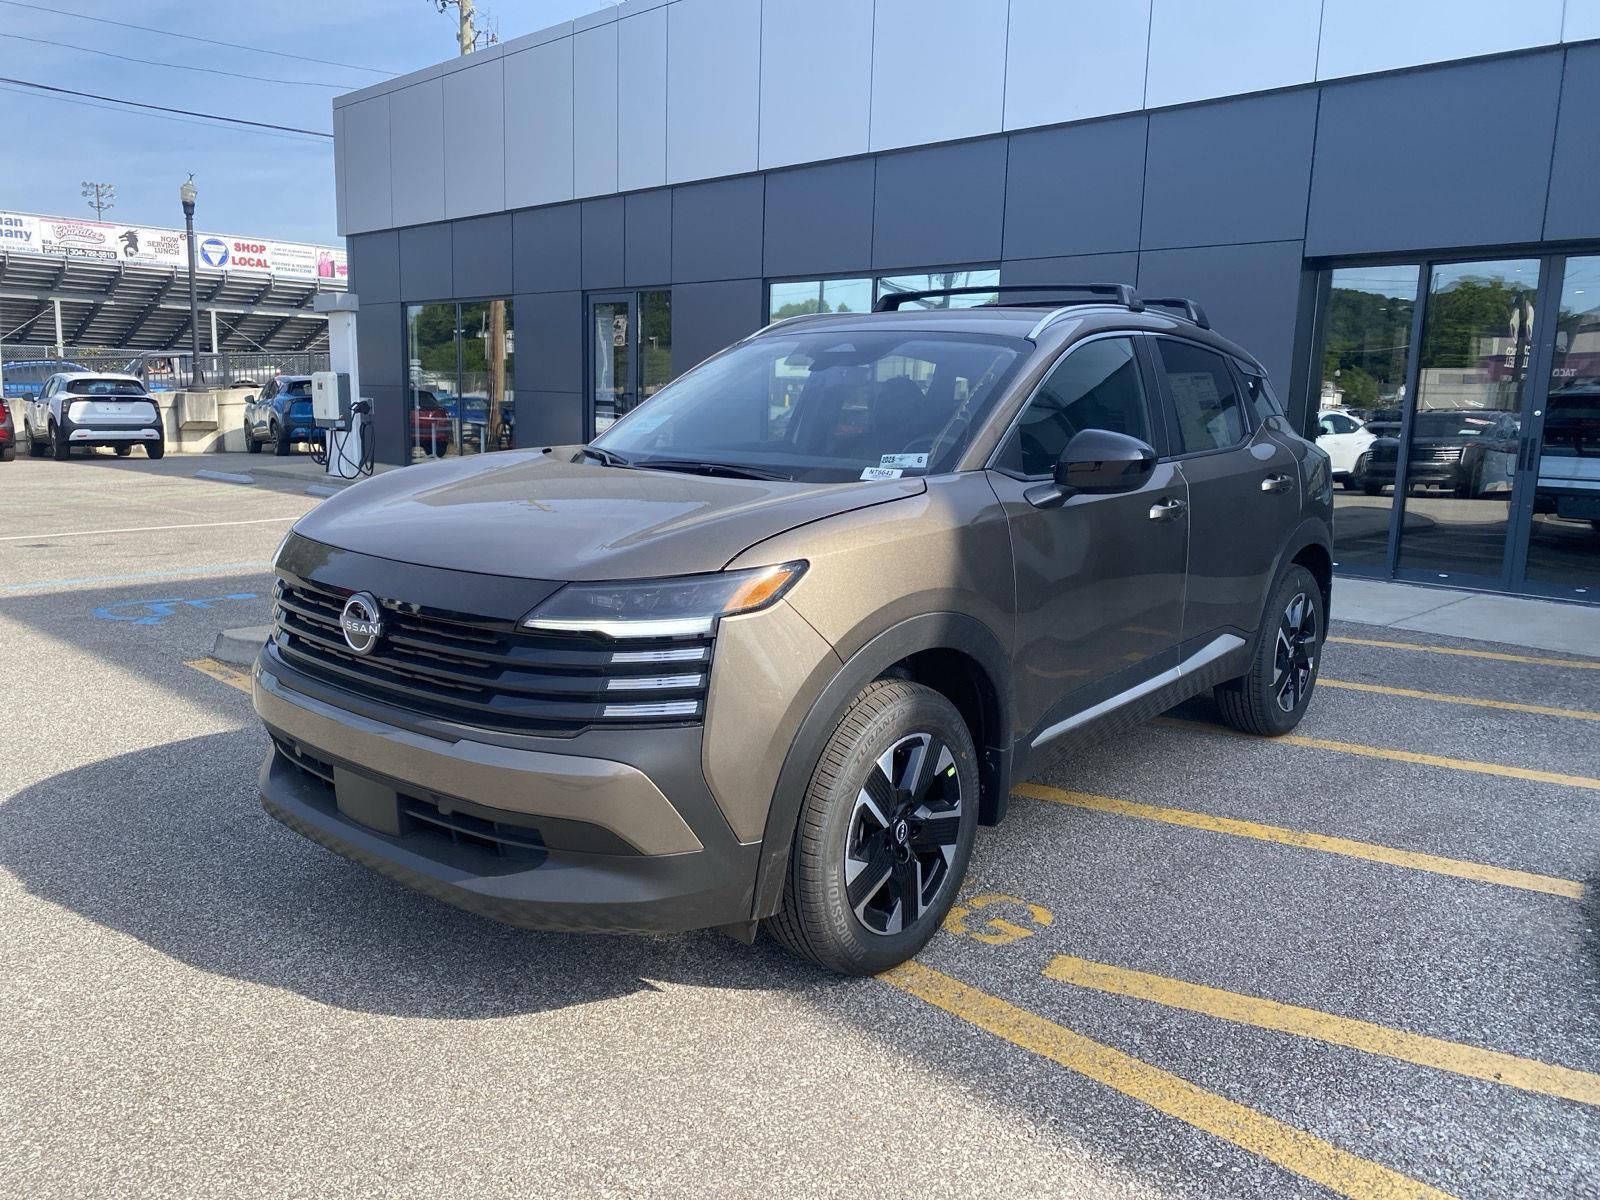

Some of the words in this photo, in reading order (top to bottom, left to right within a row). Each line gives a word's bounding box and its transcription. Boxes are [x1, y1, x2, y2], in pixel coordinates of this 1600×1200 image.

[147, 241, 179, 249] SERVING
[233, 242, 267, 254] SHOP
[154, 248, 180, 256] LUNCH
[231, 256, 271, 269] LOCAL
[917, 456, 923, 464] 6
[342, 617, 378, 634] SSAN
